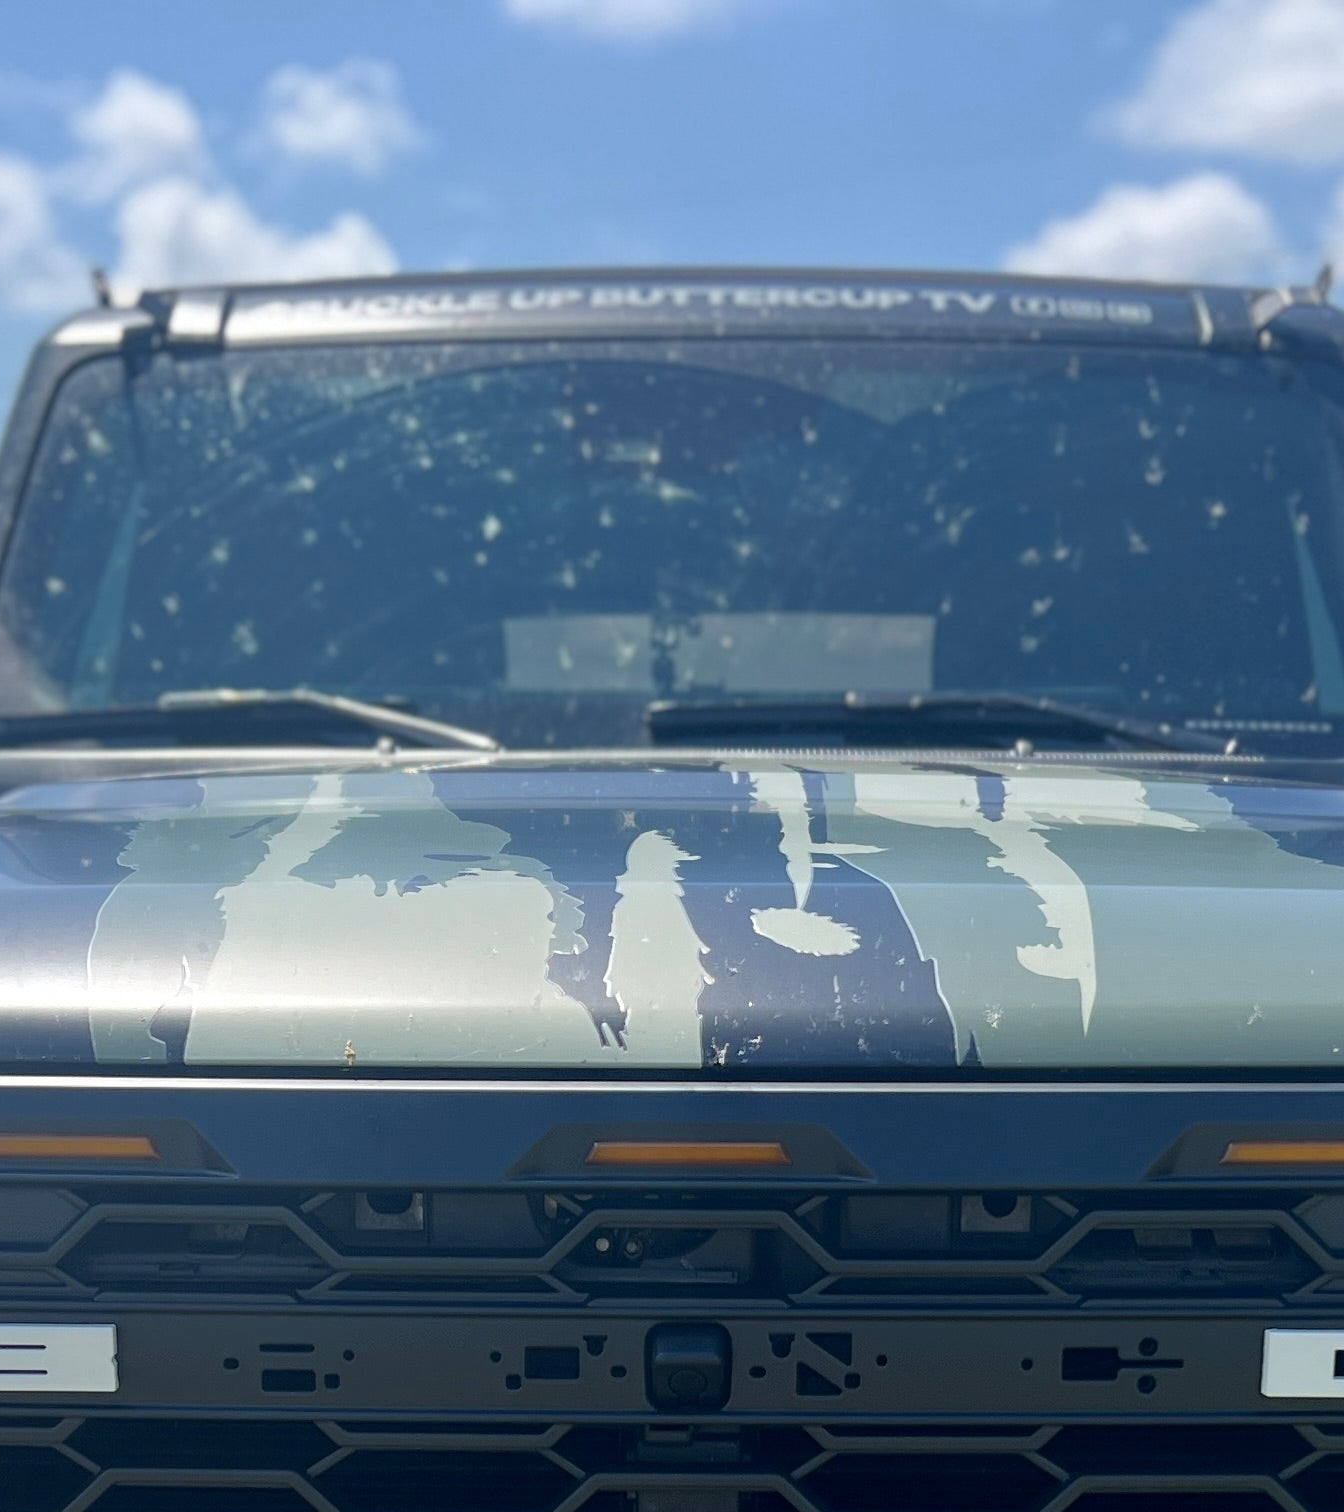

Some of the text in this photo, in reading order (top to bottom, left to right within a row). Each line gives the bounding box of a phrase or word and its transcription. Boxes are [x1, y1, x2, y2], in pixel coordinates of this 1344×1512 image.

[509, 288, 583, 311] UP
[590, 286, 912, 310] BUTTERCUP
[919, 289, 997, 314] TV
